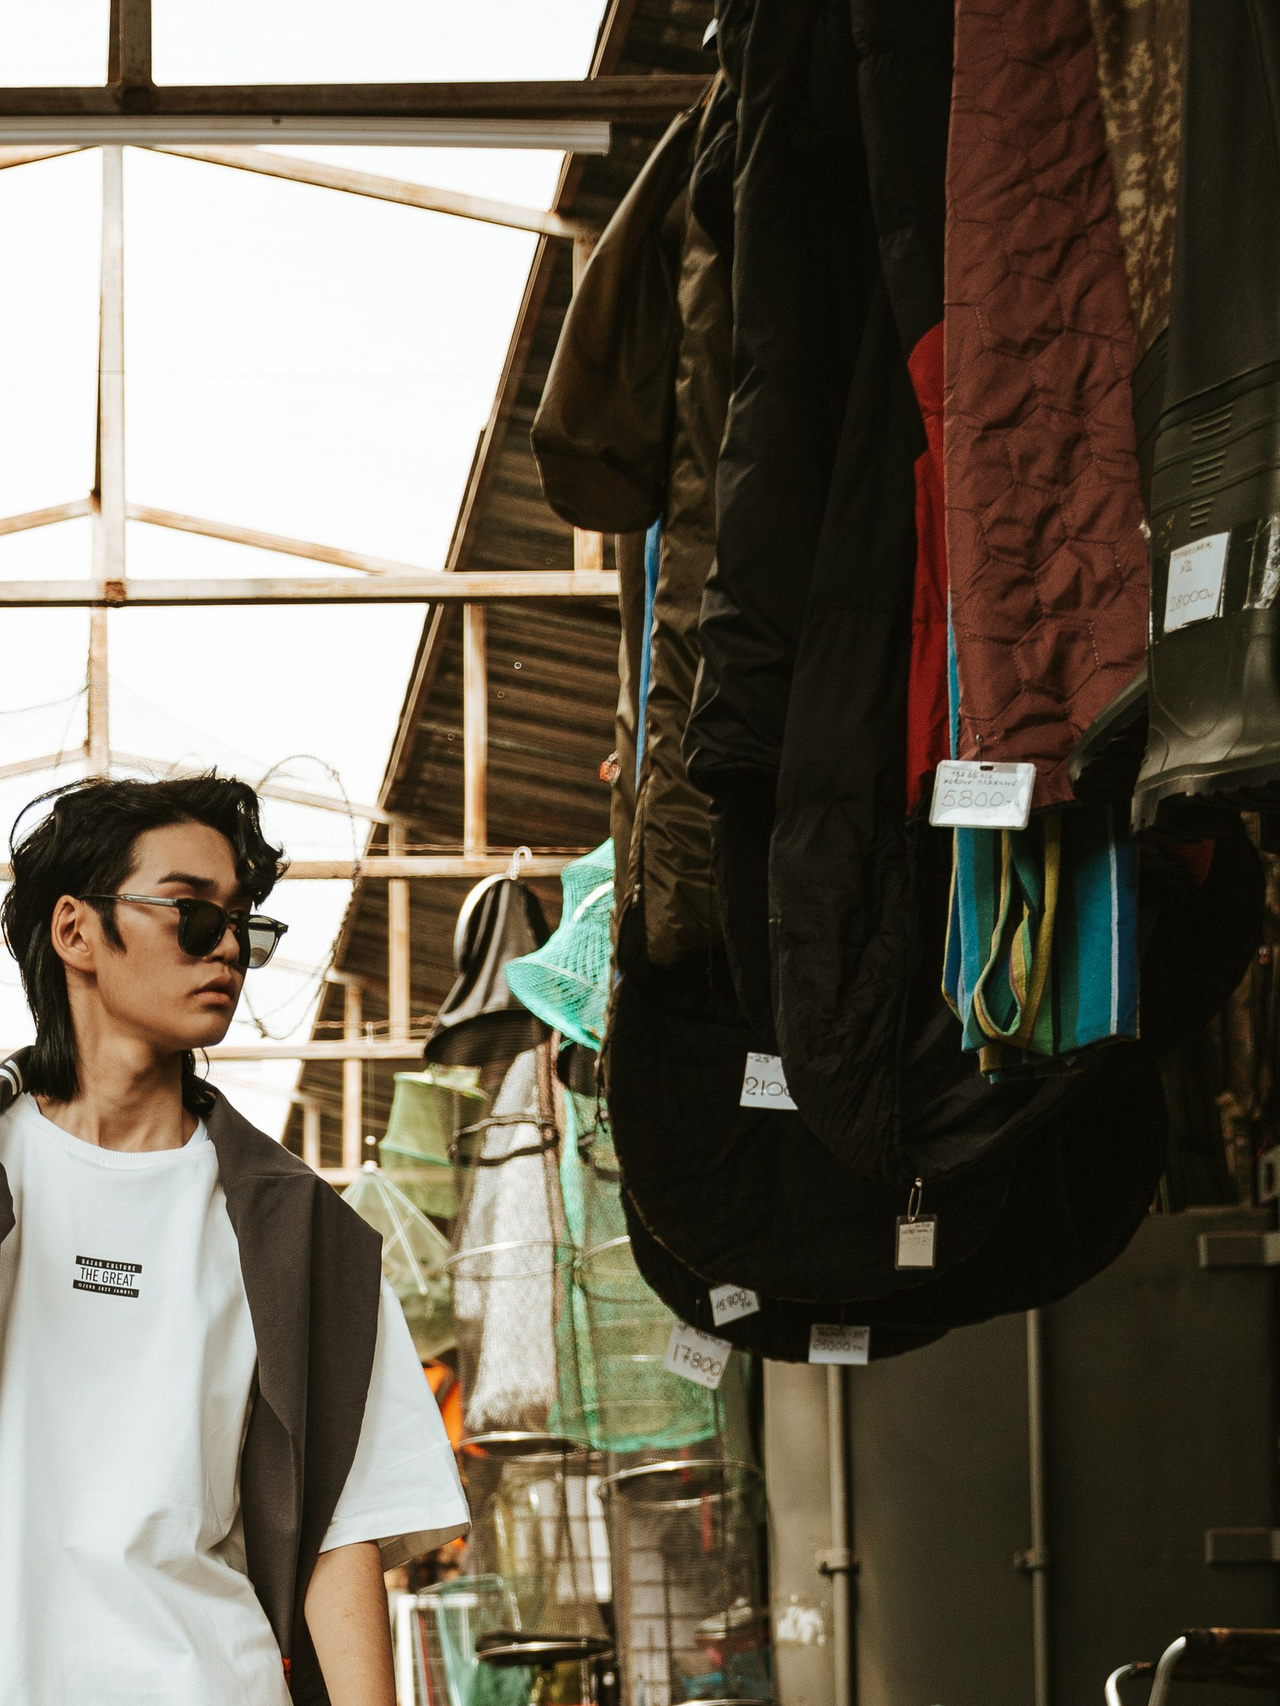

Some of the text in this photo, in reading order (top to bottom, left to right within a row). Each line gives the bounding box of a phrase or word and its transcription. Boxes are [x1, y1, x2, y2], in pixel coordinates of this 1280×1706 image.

[941, 789, 1005, 808] 5800
[81, 1258, 137, 1272] QAZAQ CULTURE
[80, 1267, 135, 1287] THE GREAT
[673, 1342, 723, 1376] 17800
